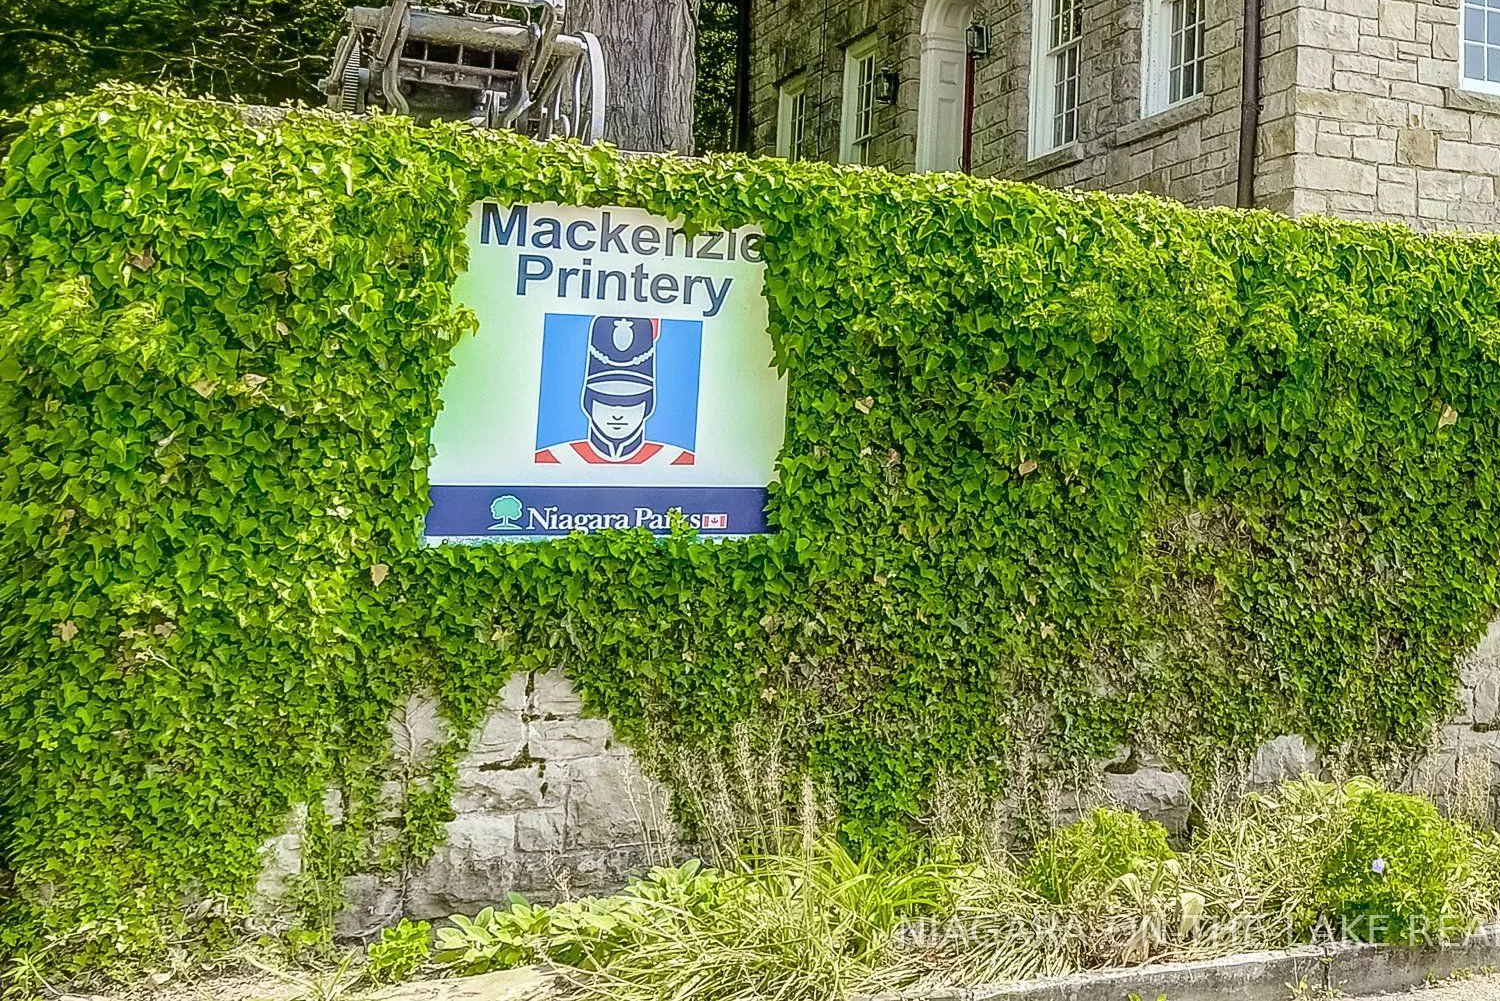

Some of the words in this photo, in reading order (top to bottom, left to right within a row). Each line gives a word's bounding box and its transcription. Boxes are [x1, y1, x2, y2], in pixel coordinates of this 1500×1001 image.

[480, 202, 764, 263] Mackenzie
[516, 253, 733, 317] Printery
[525, 506, 631, 535] Niagara
